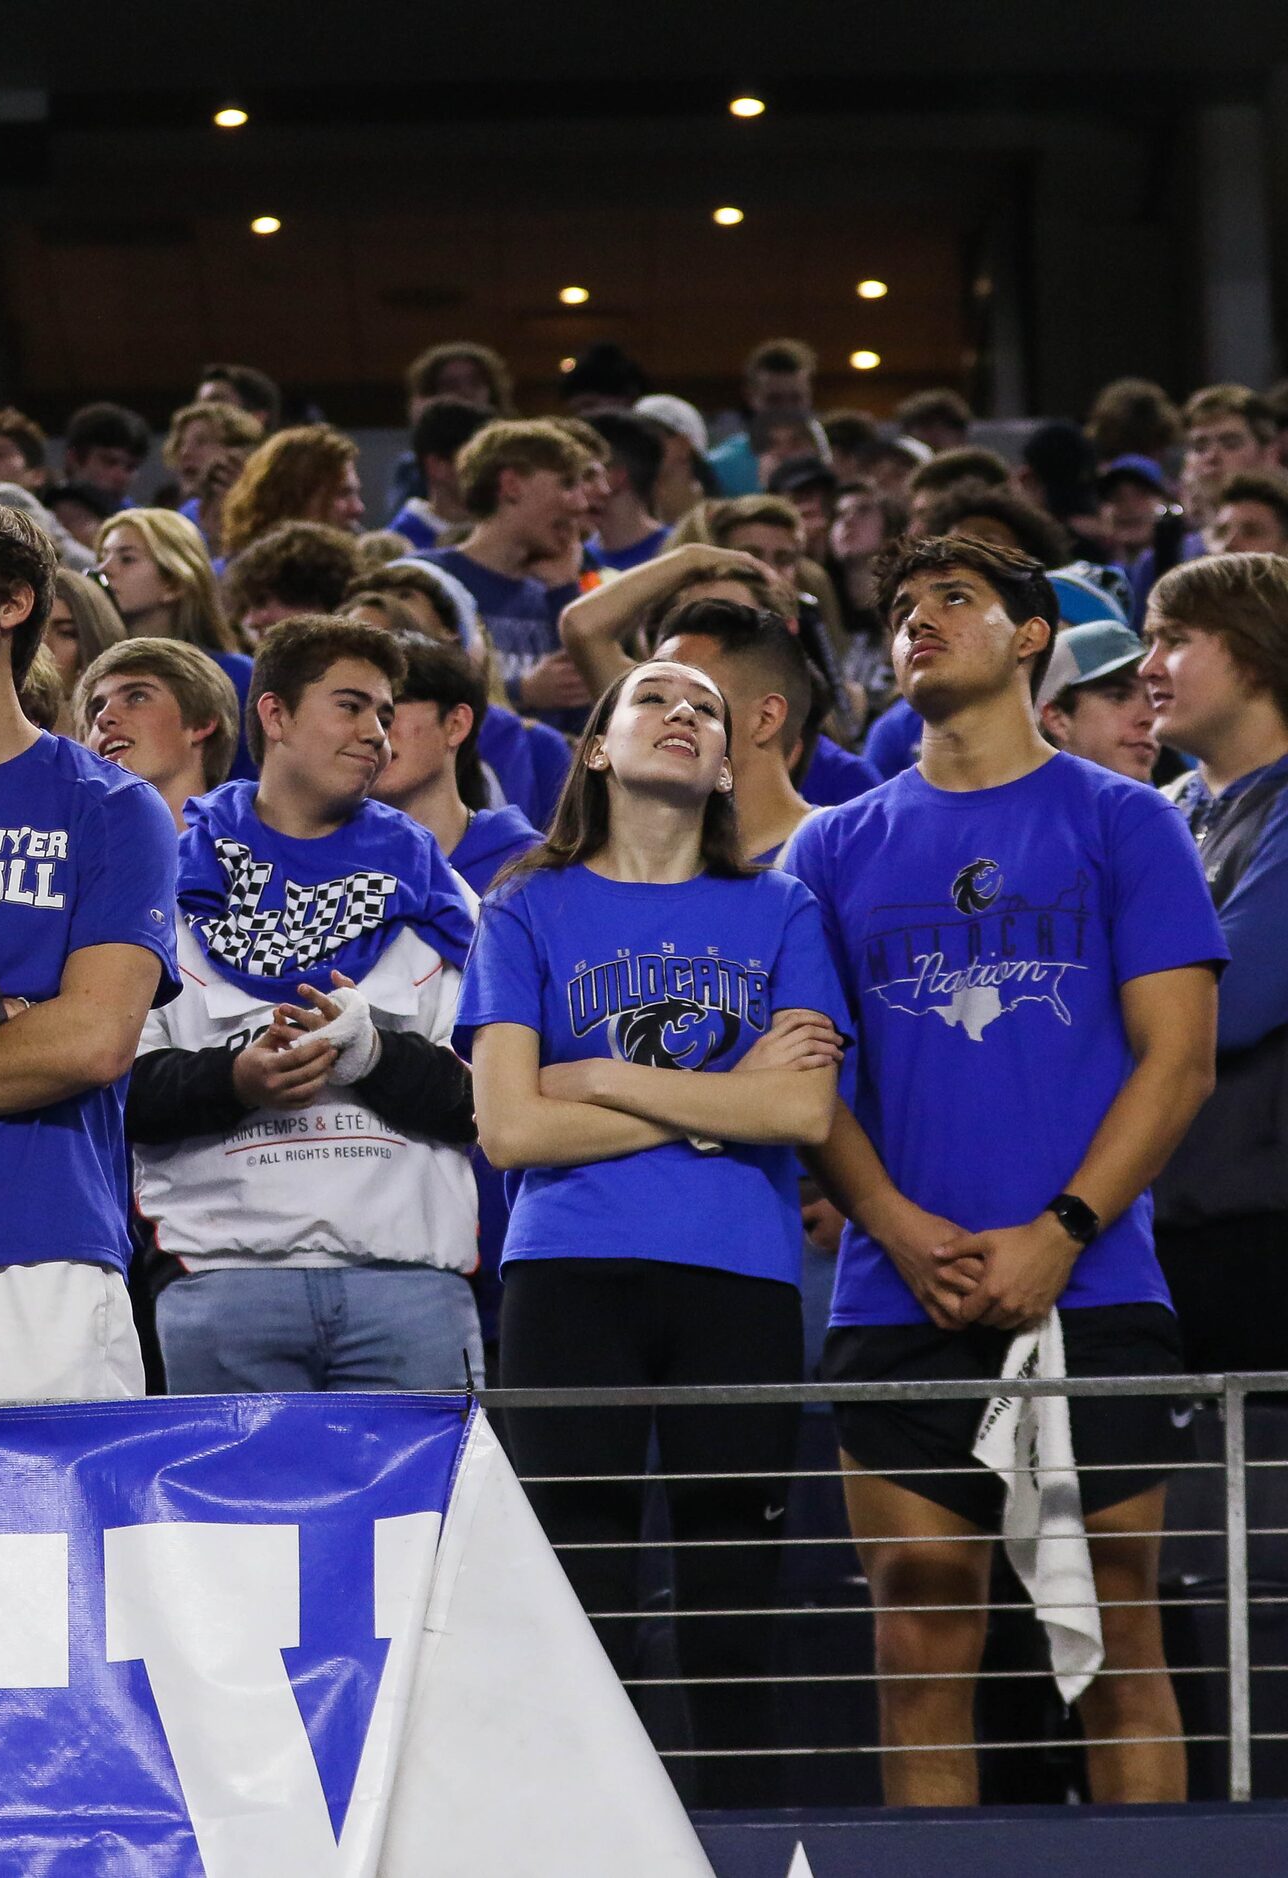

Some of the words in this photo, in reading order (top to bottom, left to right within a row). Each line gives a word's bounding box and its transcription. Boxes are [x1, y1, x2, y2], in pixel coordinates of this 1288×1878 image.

[866, 914, 1088, 981] WILDCAT
[567, 953, 769, 1039] WILDCATS
[912, 951, 1051, 999] Nation
[315, 1115, 327, 1132] &
[335, 1112, 365, 1131] ÉTÉ
[259, 1153, 281, 1166] ALL
[285, 1148, 330, 1162] RIGHTS
[334, 1146, 392, 1160] RESERVED
[978, 1397, 1013, 1441] livers
